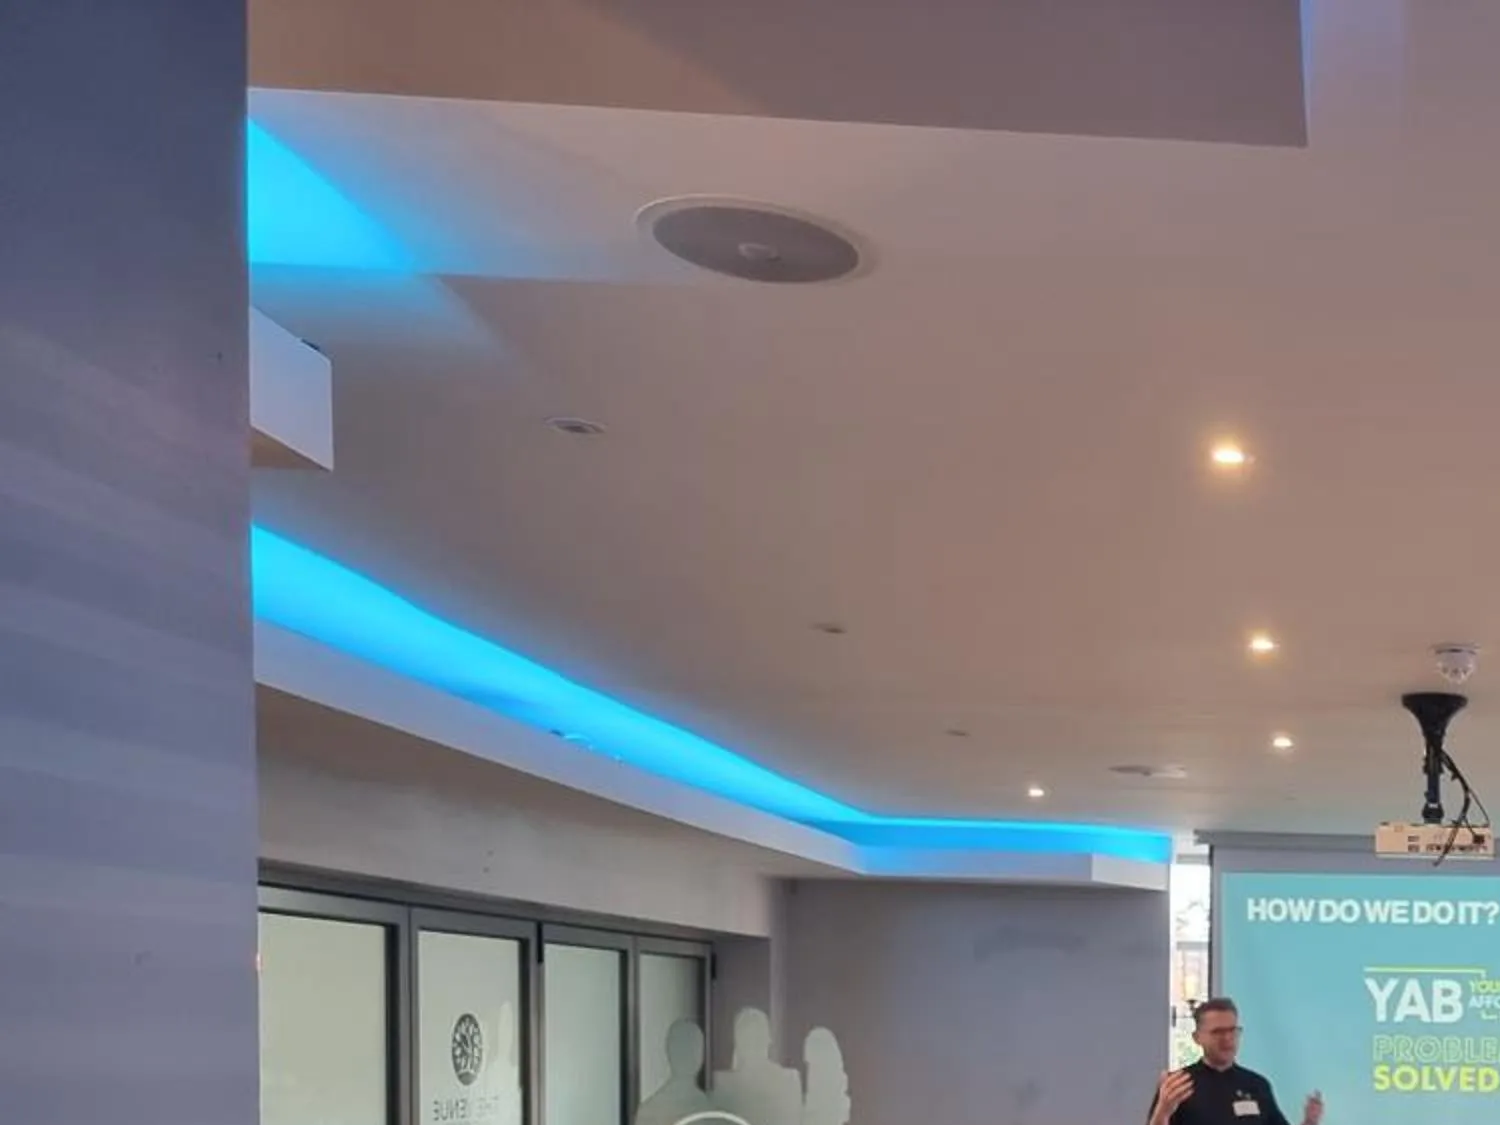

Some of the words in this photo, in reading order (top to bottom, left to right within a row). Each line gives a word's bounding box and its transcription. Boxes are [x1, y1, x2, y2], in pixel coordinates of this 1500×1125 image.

[1248, 898, 1315, 922] HOW
[1318, 899, 1361, 923] DO
[1364, 901, 1410, 924] WE
[1412, 901, 1455, 925] DO
[1457, 902, 1500, 925] IT?
[1364, 978, 1465, 1023] YAB
